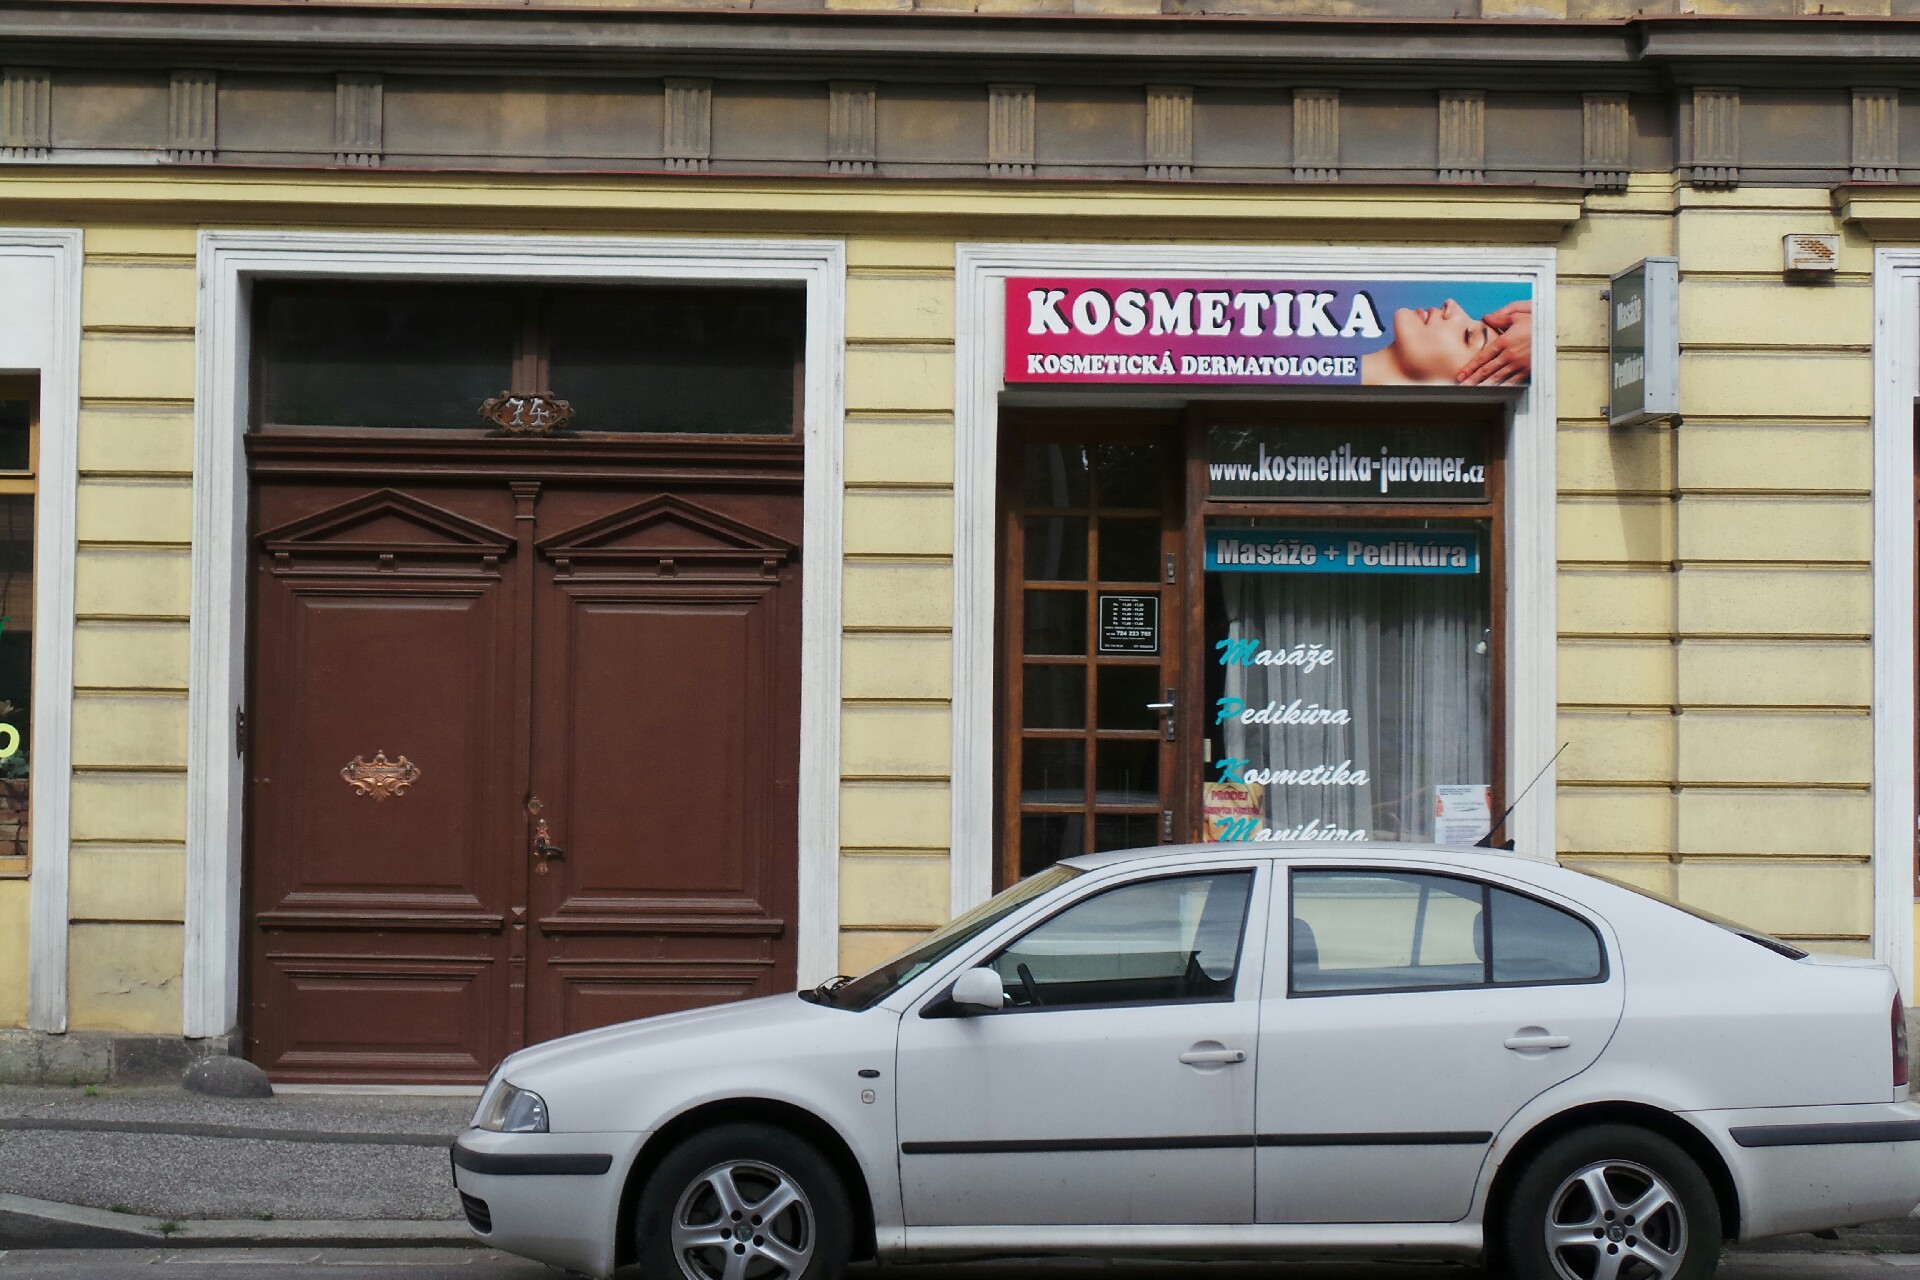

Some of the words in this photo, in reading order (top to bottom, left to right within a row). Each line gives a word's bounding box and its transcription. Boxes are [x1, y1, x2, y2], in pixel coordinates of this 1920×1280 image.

[1026, 289, 1384, 338] KOSMETIKA
[1027, 350, 1177, 376] KOSMETICKÁ
[1180, 355, 1358, 378] DERMATOLOGIE
[505, 397, 550, 427] 74
[1208, 442, 1486, 494] www.kosmetika-jaromer.cz
[1216, 538, 1318, 565] Masáže
[1323, 544, 1341, 561] +
[1346, 539, 1468, 567] Pedikúra
[1215, 638, 1335, 674] Masáže
[1215, 697, 1352, 726] Pedikúra
[1215, 758, 1371, 786] Kosmetika
